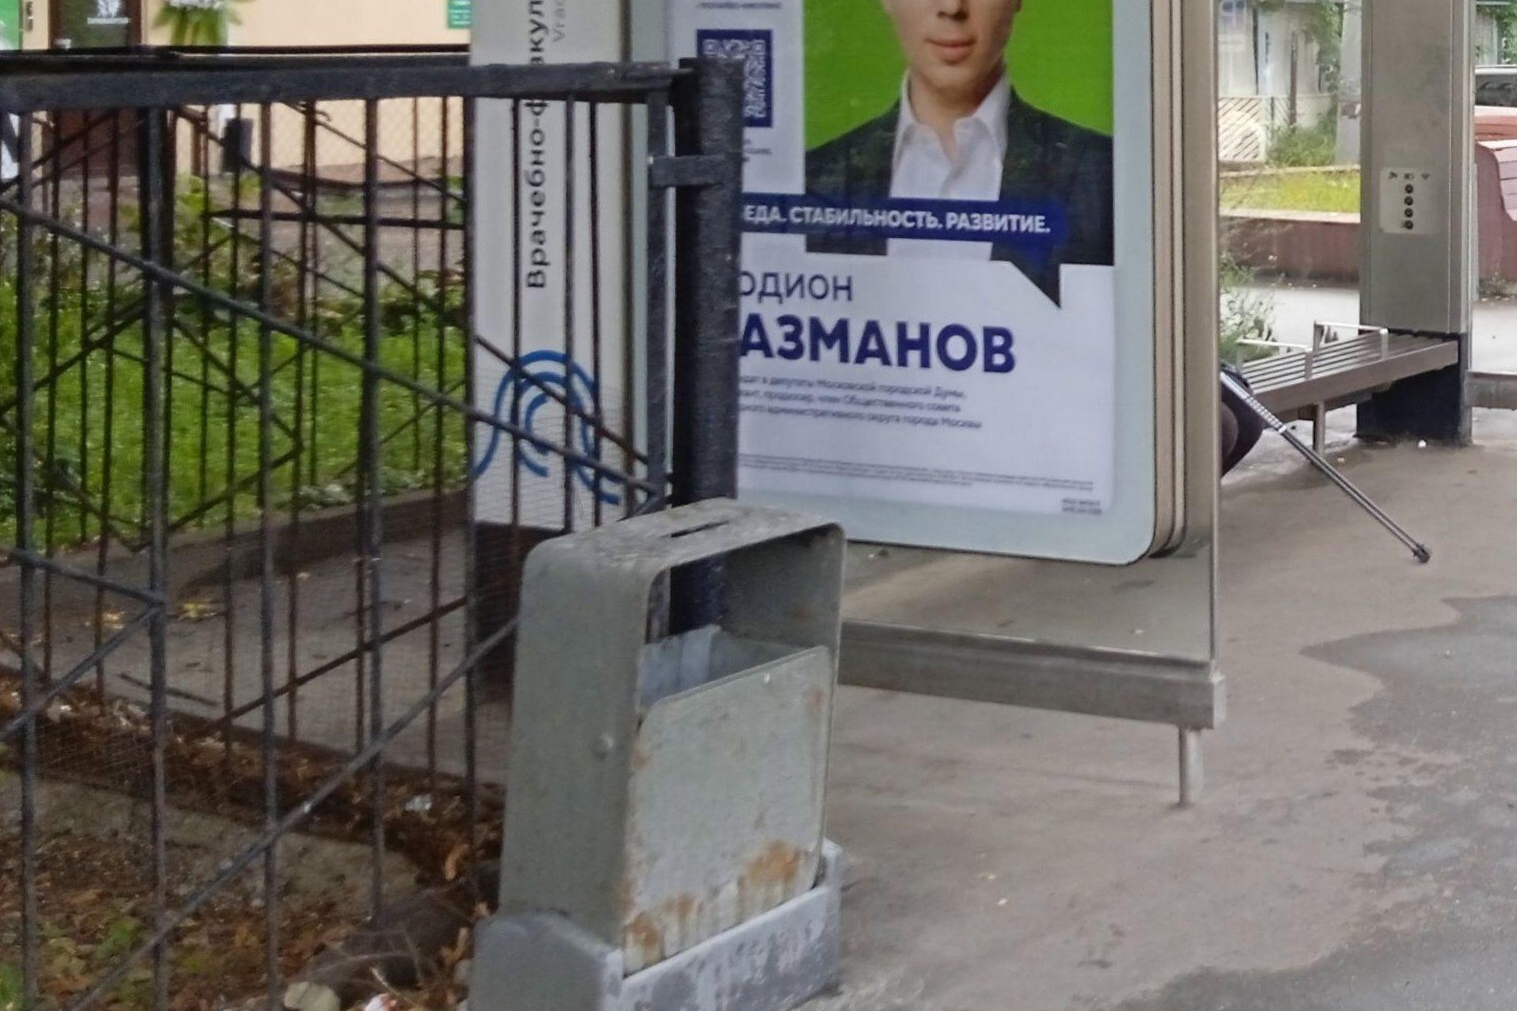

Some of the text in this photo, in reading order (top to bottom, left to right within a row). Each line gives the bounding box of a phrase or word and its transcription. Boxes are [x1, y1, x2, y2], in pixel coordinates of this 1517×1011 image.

[742, 204, 1051, 234] ЕДА. СТАБИЛЬНОСТЬ. РАЗВИТИЕ.
[740, 270, 854, 305] ОДИОН
[739, 312, 1016, 374] АЗМАНОВ
